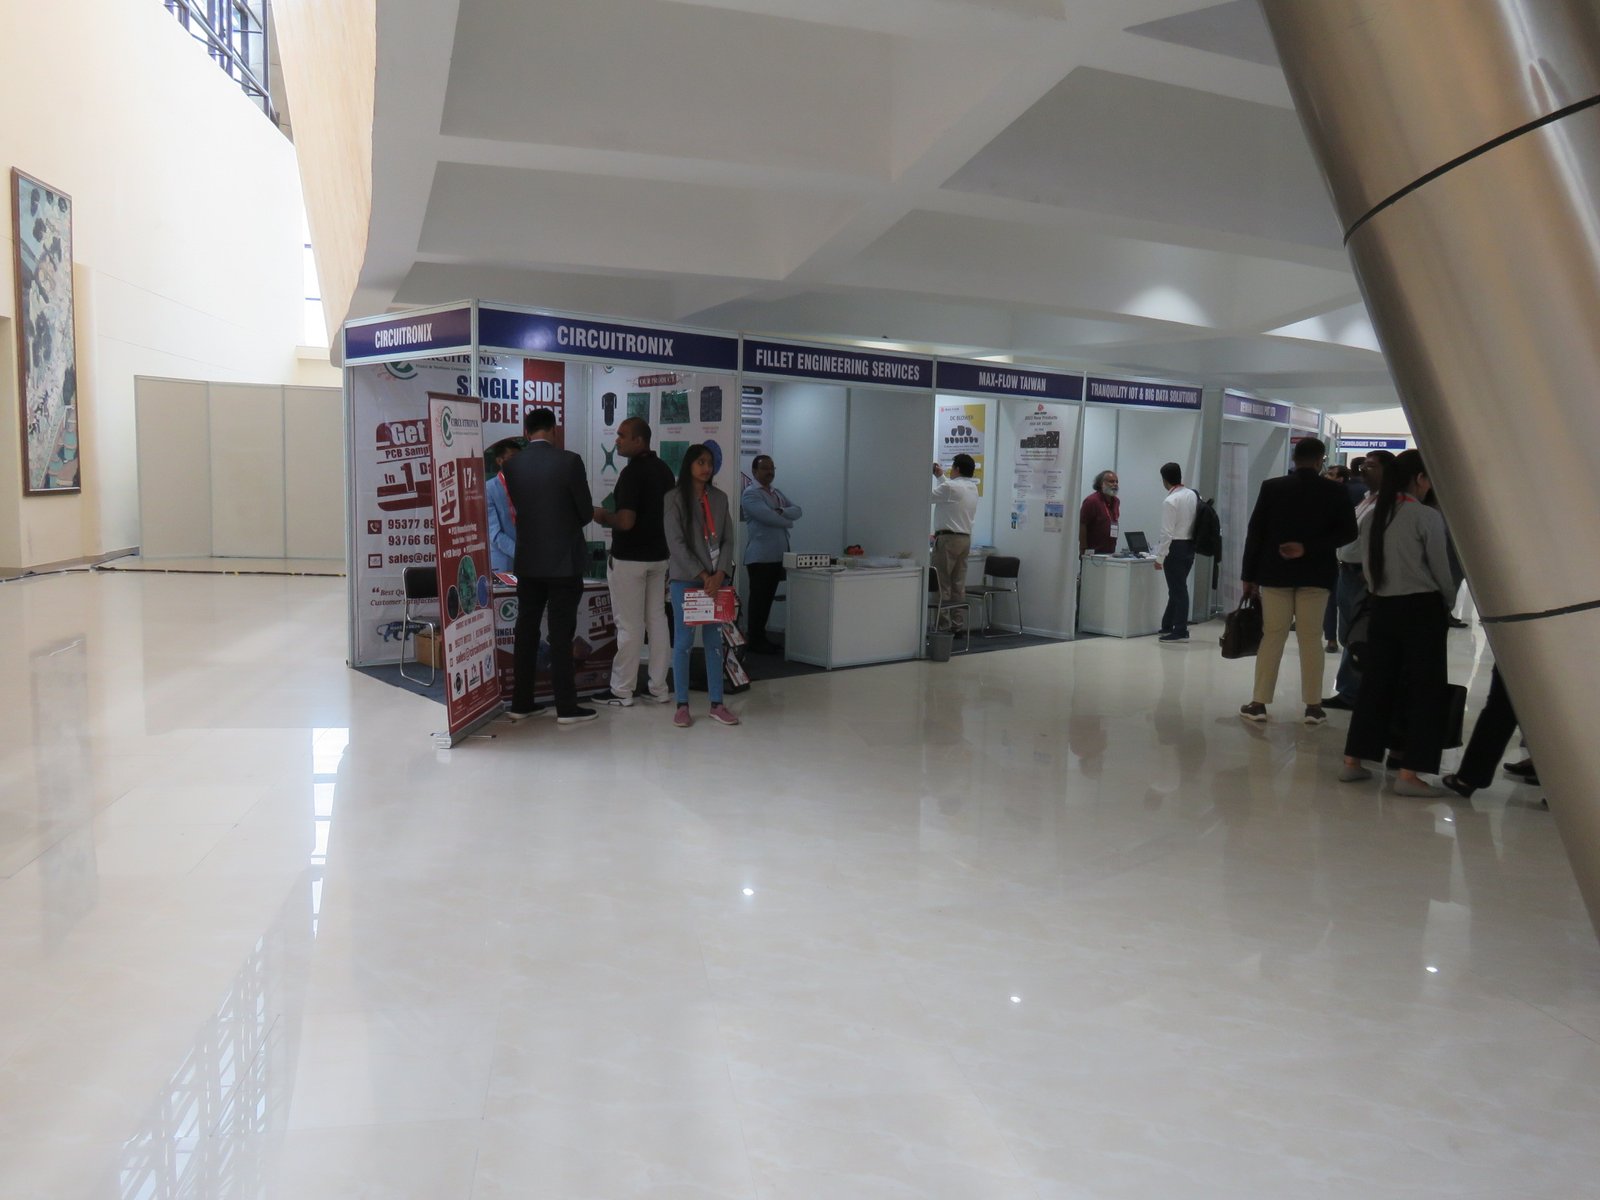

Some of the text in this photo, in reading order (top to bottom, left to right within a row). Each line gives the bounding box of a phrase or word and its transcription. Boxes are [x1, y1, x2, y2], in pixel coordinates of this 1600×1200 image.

[374, 322, 433, 349] CIRCUITRONIX
[556, 325, 674, 357] CIRCUITRONIX
[756, 348, 920, 381] FILLET ENGINEERING SERVICES
[456, 375, 563, 403] SNGLE SIDE
[978, 371, 1047, 392] MAX-FLOW TAIWAN
[1091, 382, 1128, 399] TRANQUILITY
[1144, 388, 1155, 401] BIG
[1155, 389, 1169, 402] DATA
[1169, 390, 1198, 404] SOLUTIONS
[480, 401, 519, 424] UBLE
[391, 420, 427, 446] Get
[385, 446, 429, 459] PCB Samp
[384, 473, 396, 485] In
[400, 462, 417, 493] 1
[388, 518, 435, 530] 95377 89
[388, 535, 436, 546] 93766 66
[388, 552, 436, 564] sales@cir
